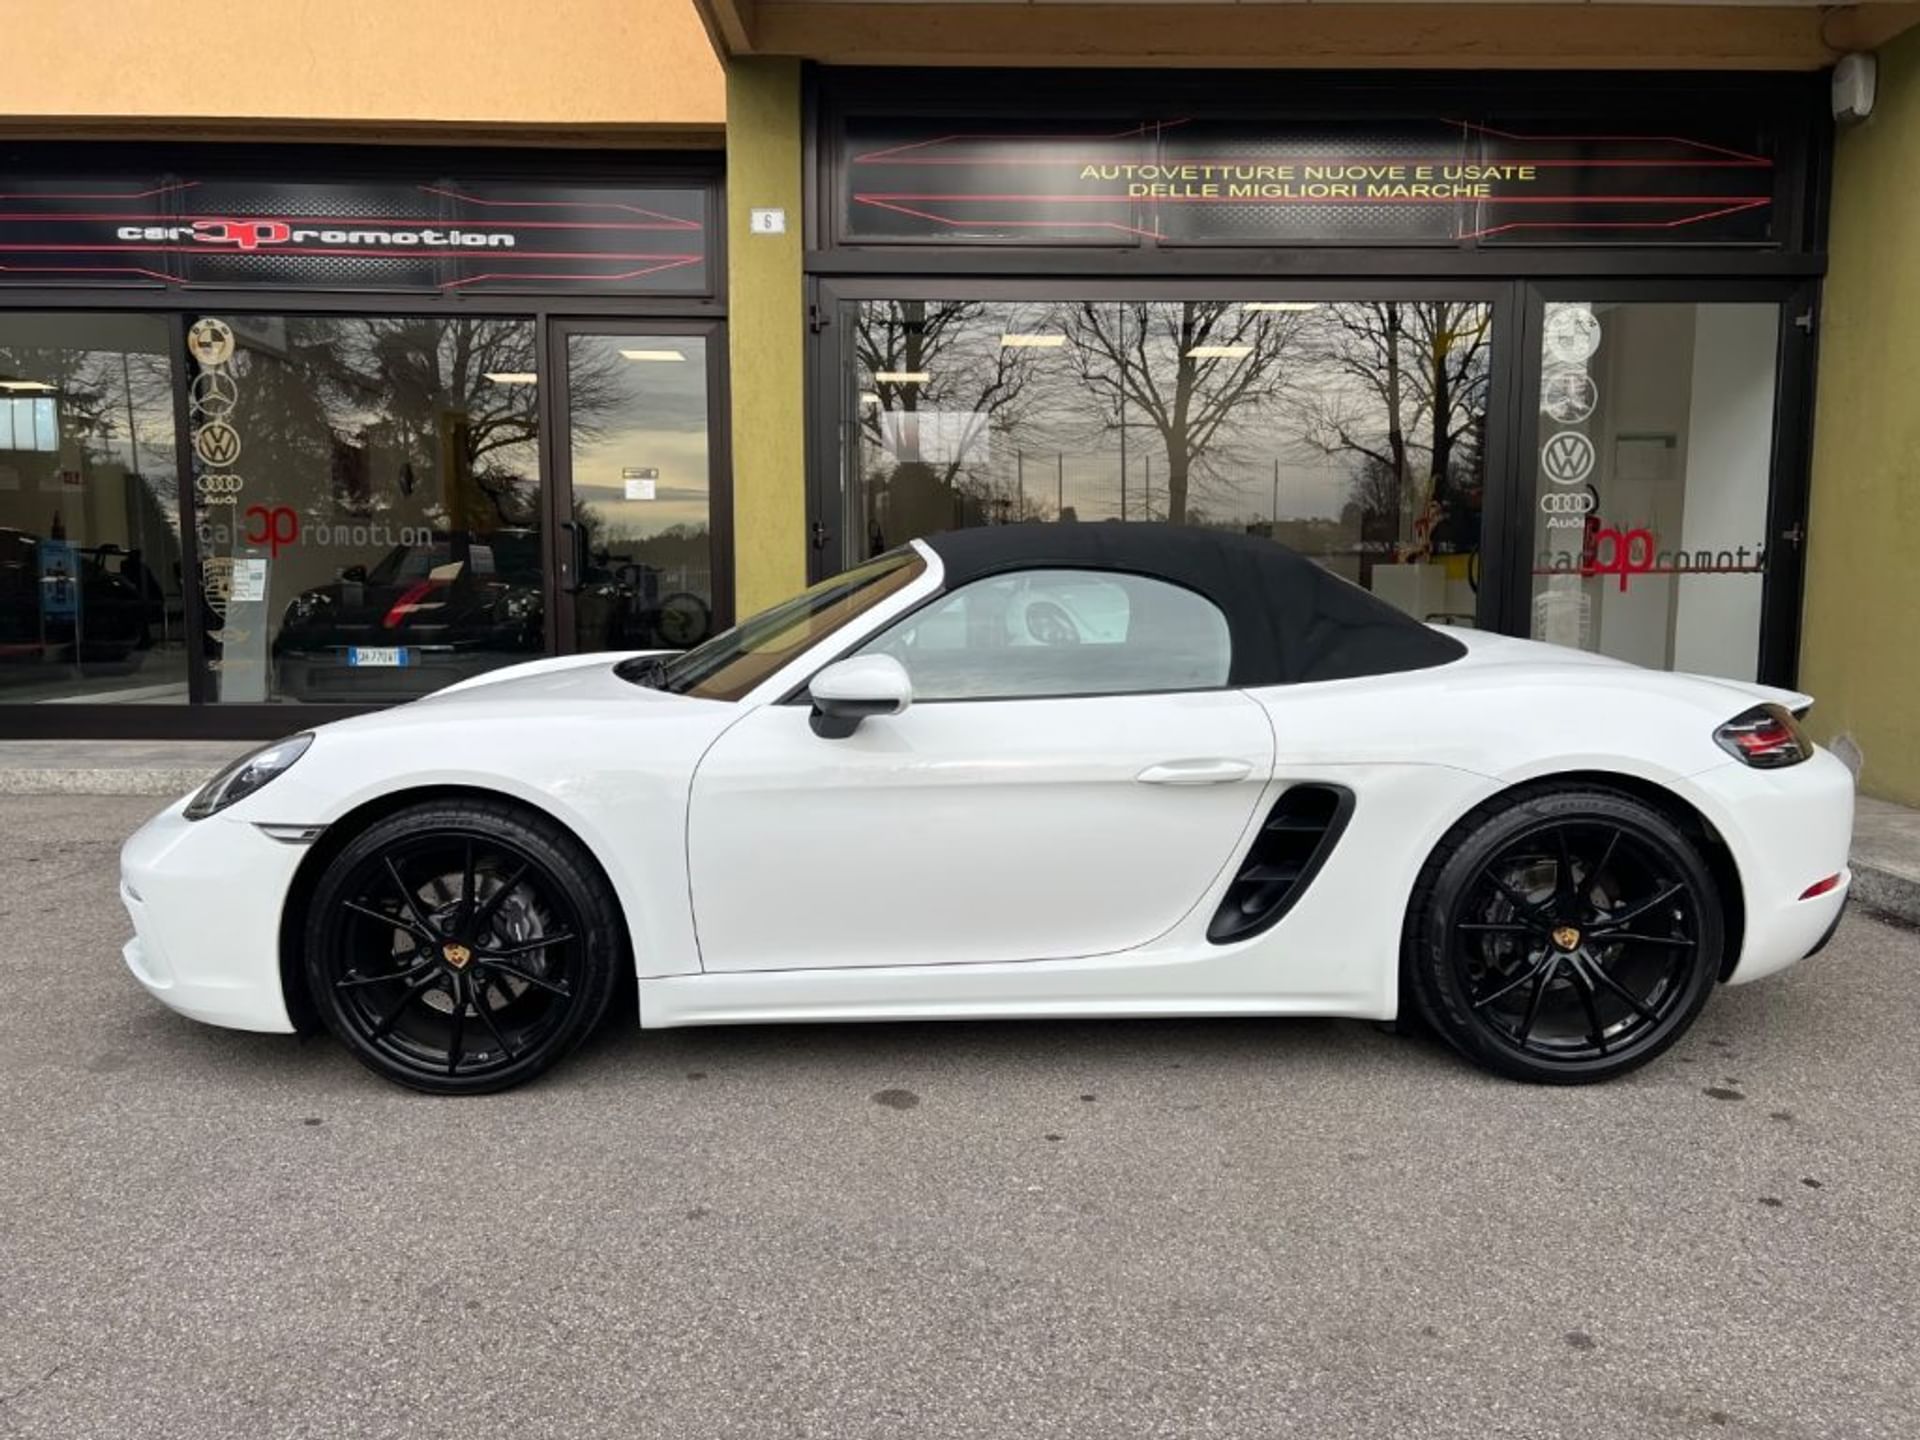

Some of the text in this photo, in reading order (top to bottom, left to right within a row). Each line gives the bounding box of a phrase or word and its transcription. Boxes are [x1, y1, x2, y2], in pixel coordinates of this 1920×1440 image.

[1079, 164, 1537, 181] AUTOVETTURE NUOVE E USATE
[1128, 183, 1492, 199] DELLE MIGLIORI MARCHE
